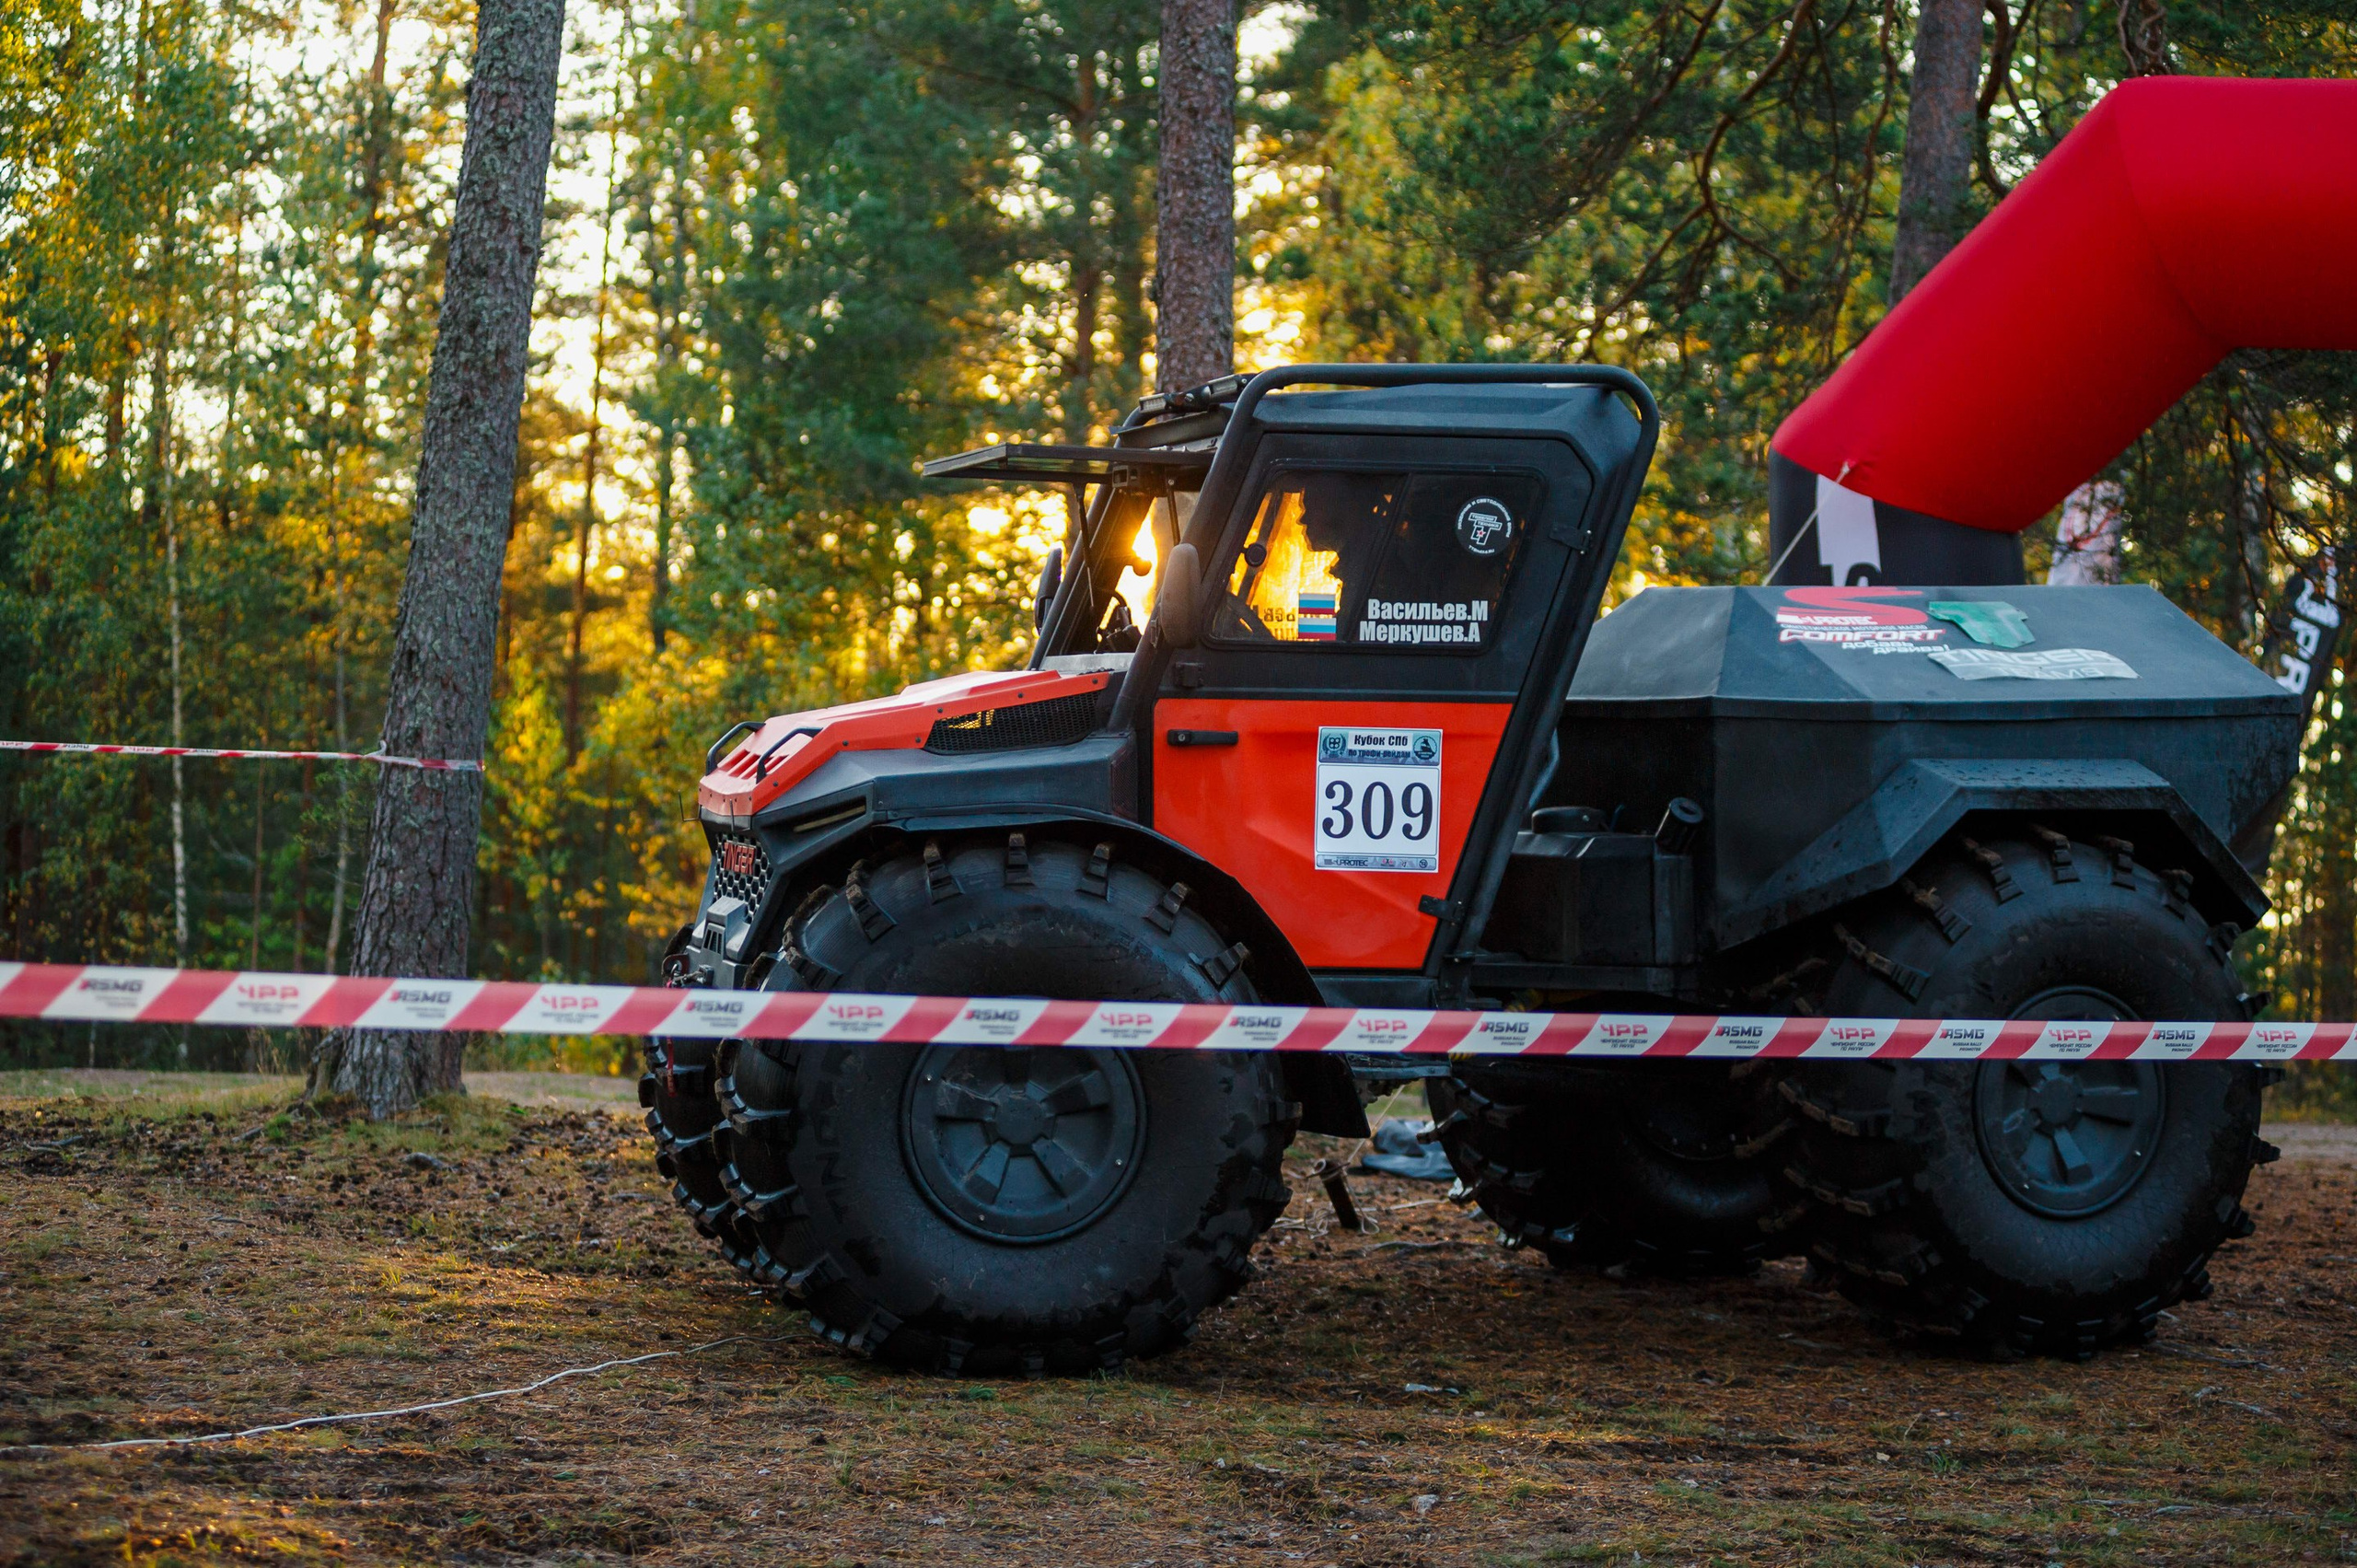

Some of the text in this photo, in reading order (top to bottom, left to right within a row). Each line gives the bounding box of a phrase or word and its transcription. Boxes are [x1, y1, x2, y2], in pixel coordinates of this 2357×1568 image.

[1367, 598, 1488, 621] Васильев.М
[1359, 621, 1480, 644] Меркушев.А
[1780, 628, 1945, 642] COMFORT
[1353, 735, 1409, 747] Кубок СПб
[1322, 780, 1433, 841] 309
[723, 842, 756, 875] TINGER
